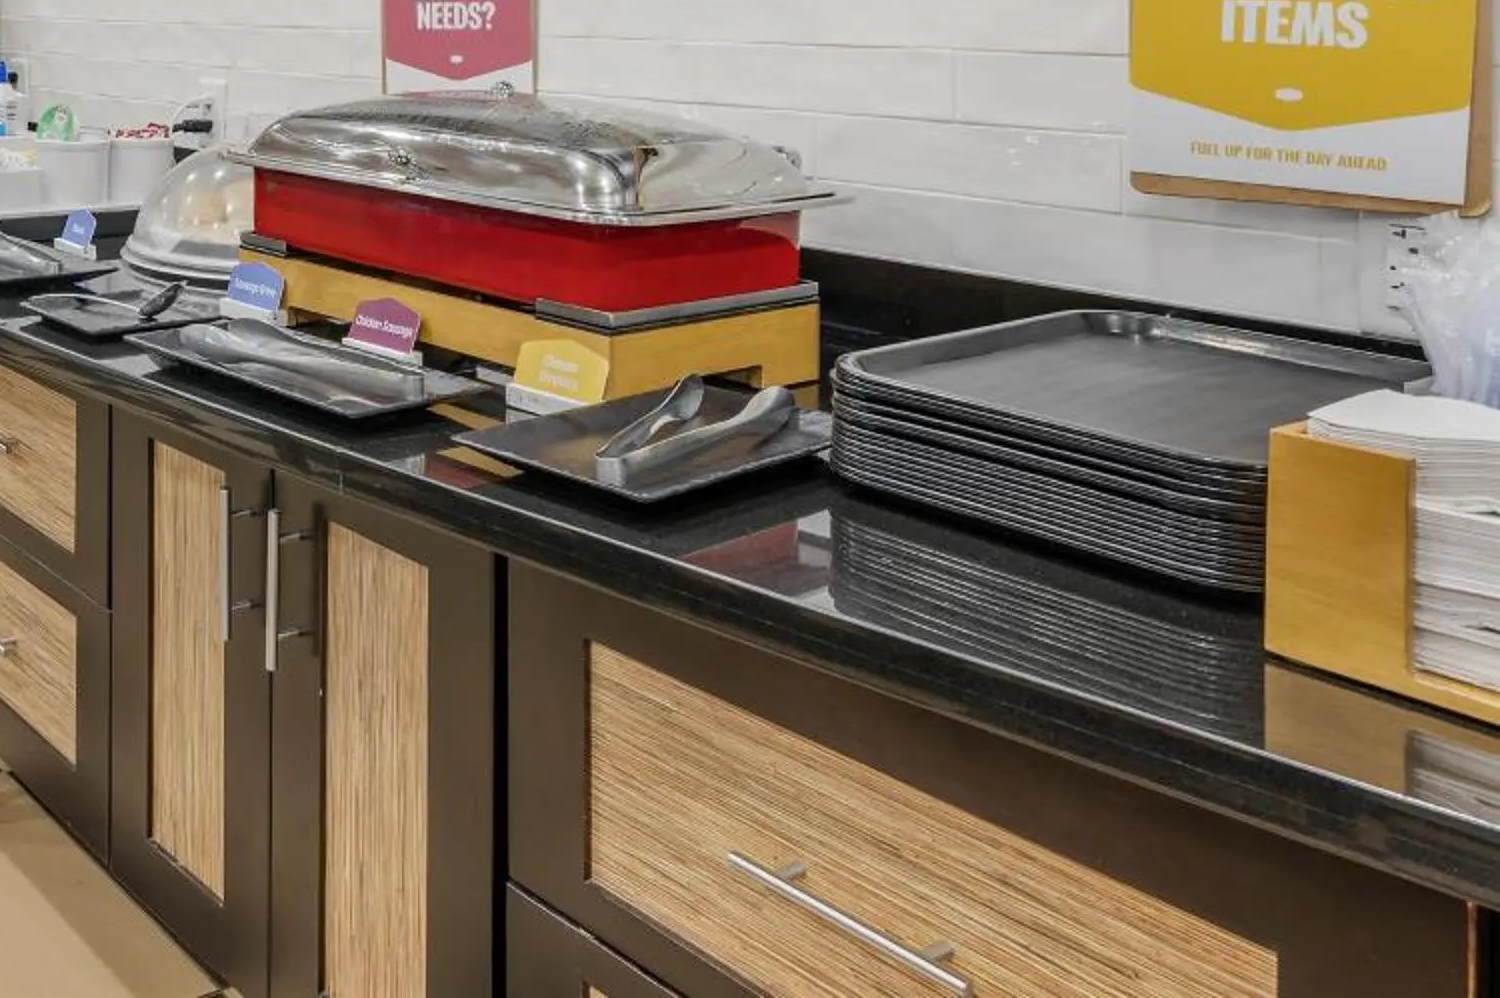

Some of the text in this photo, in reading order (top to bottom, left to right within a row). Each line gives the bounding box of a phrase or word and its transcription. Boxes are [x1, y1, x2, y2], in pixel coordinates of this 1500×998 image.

[417, 1, 496, 30] NEEDS?
[1190, 140, 1388, 172] FUEL UP FOR THE DAY AHEAD
